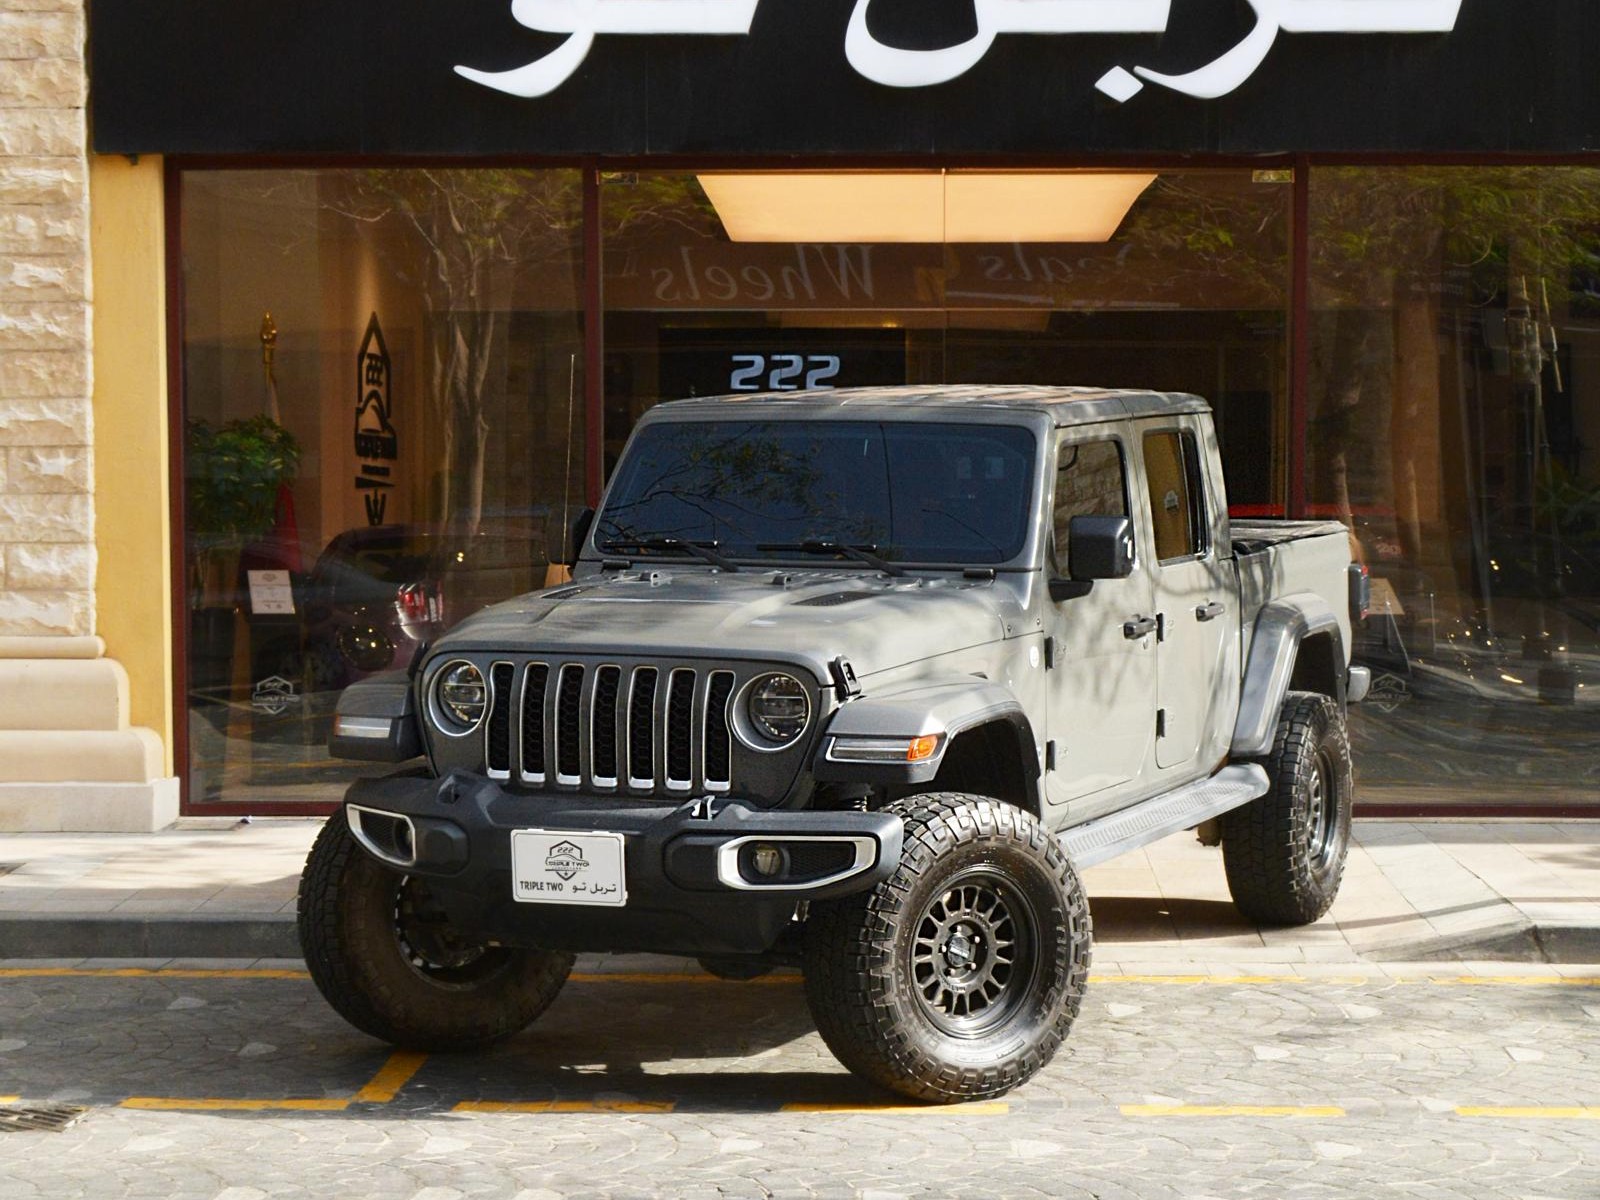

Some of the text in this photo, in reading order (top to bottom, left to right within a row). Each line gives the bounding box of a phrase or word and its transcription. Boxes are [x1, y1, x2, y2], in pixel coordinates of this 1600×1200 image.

[730, 354, 840, 390] 222
[520, 880, 563, 892] TRIPLE TWO
[572, 881, 587, 893] تو
